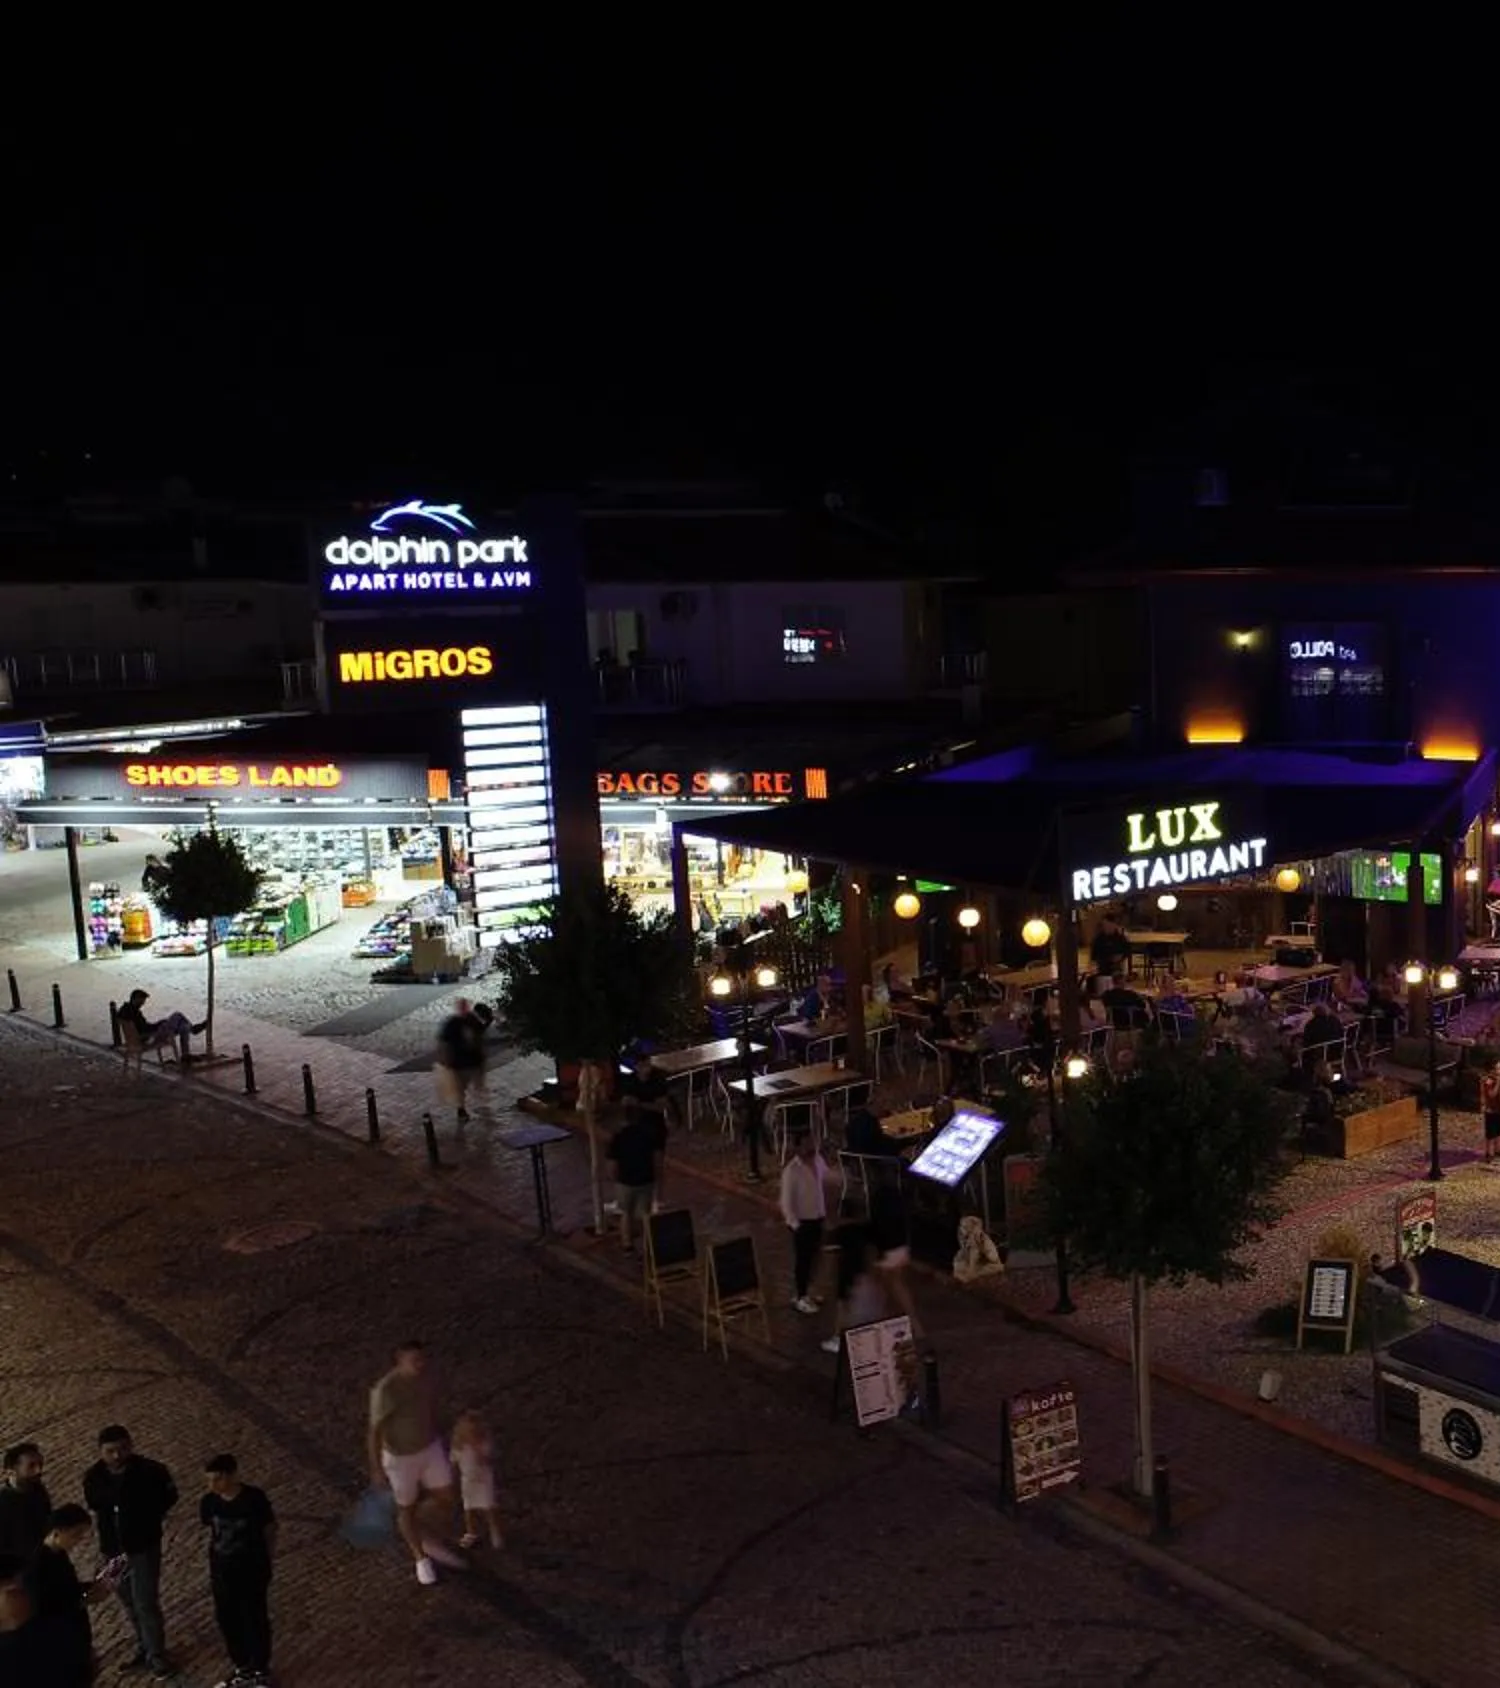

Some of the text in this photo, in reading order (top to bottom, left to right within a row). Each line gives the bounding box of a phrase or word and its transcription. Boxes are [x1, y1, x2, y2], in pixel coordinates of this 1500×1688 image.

[325, 535, 528, 570] dolphin park
[330, 571, 532, 591] APART HOTEL & AVM
[126, 763, 342, 788] SHOES LAND
[597, 770, 793, 795] BAGS SORE
[1127, 801, 1222, 852] LUX
[1072, 837, 1267, 901] RESTAURANT
